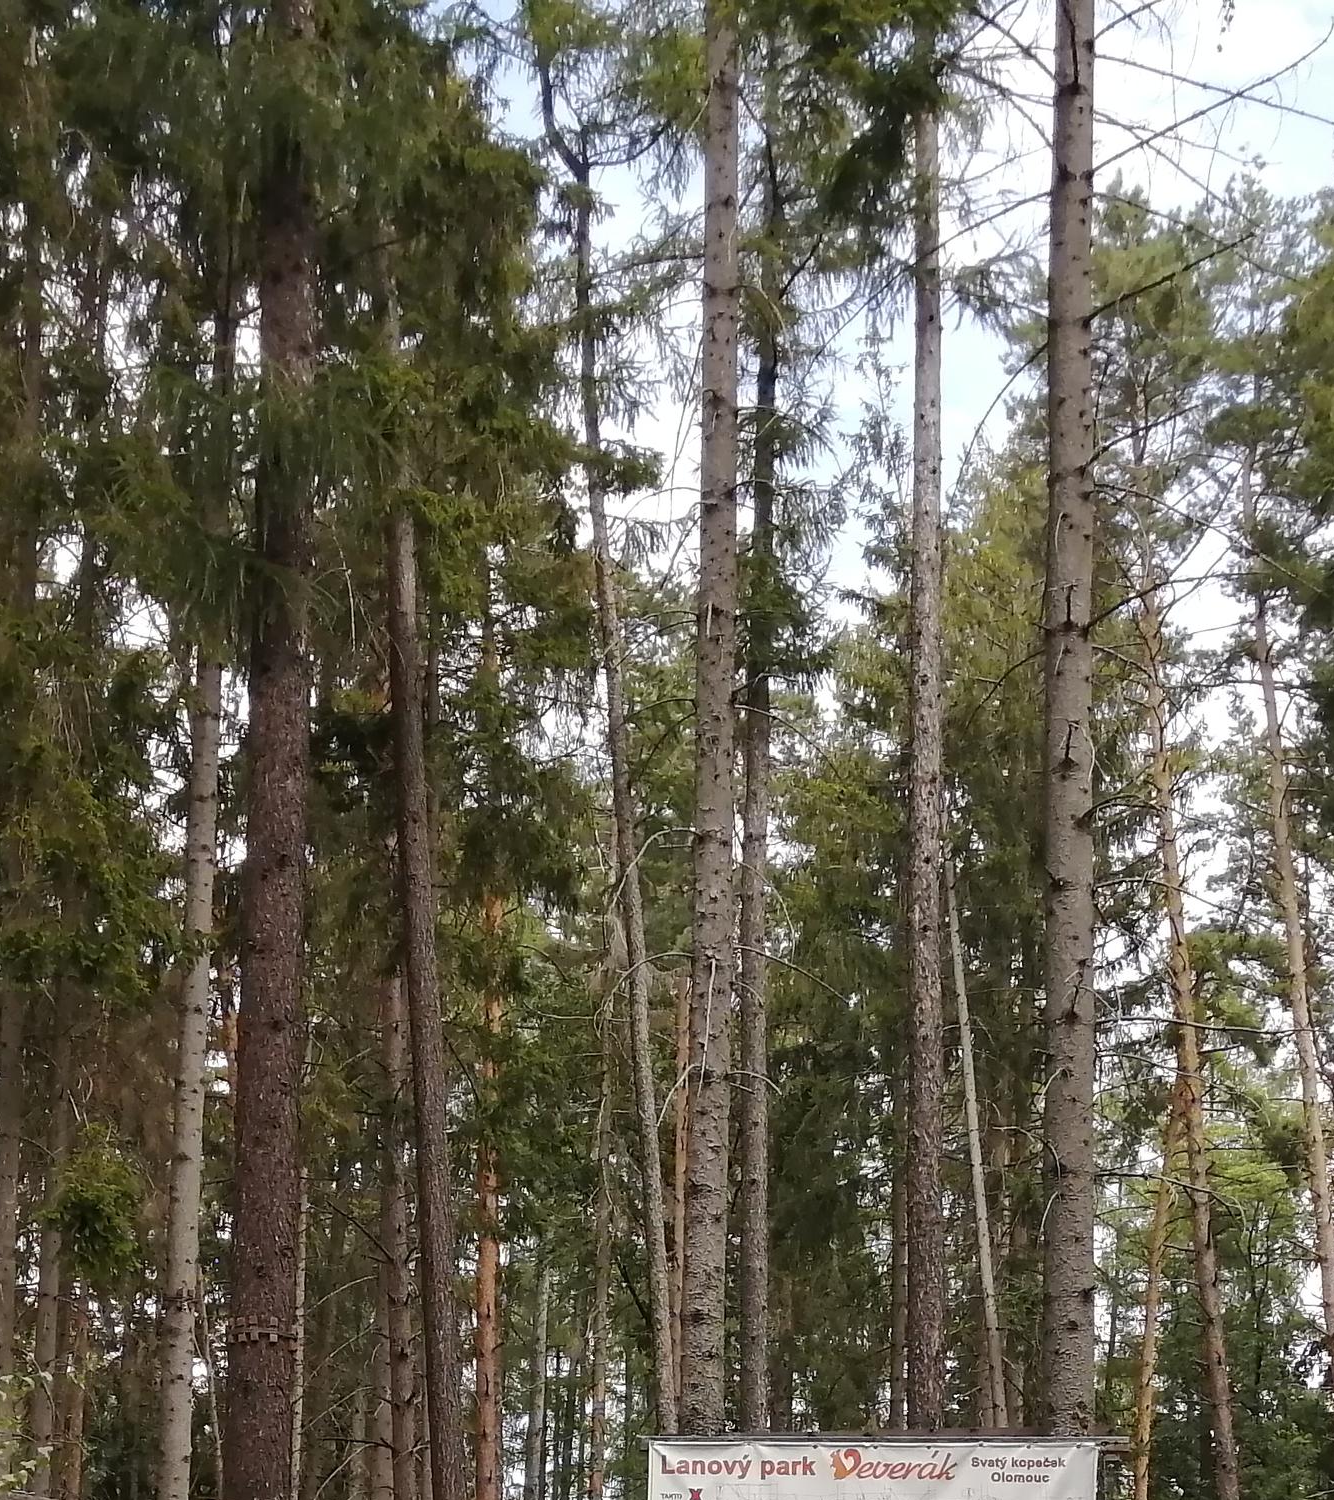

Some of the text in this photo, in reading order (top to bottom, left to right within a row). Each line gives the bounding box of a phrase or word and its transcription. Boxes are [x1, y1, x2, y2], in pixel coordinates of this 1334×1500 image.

[660, 1448, 958, 1481] Lanový park Veverák
[971, 1455, 1066, 1471] Svatý kopeček
[991, 1471, 1050, 1483] Olomouc
